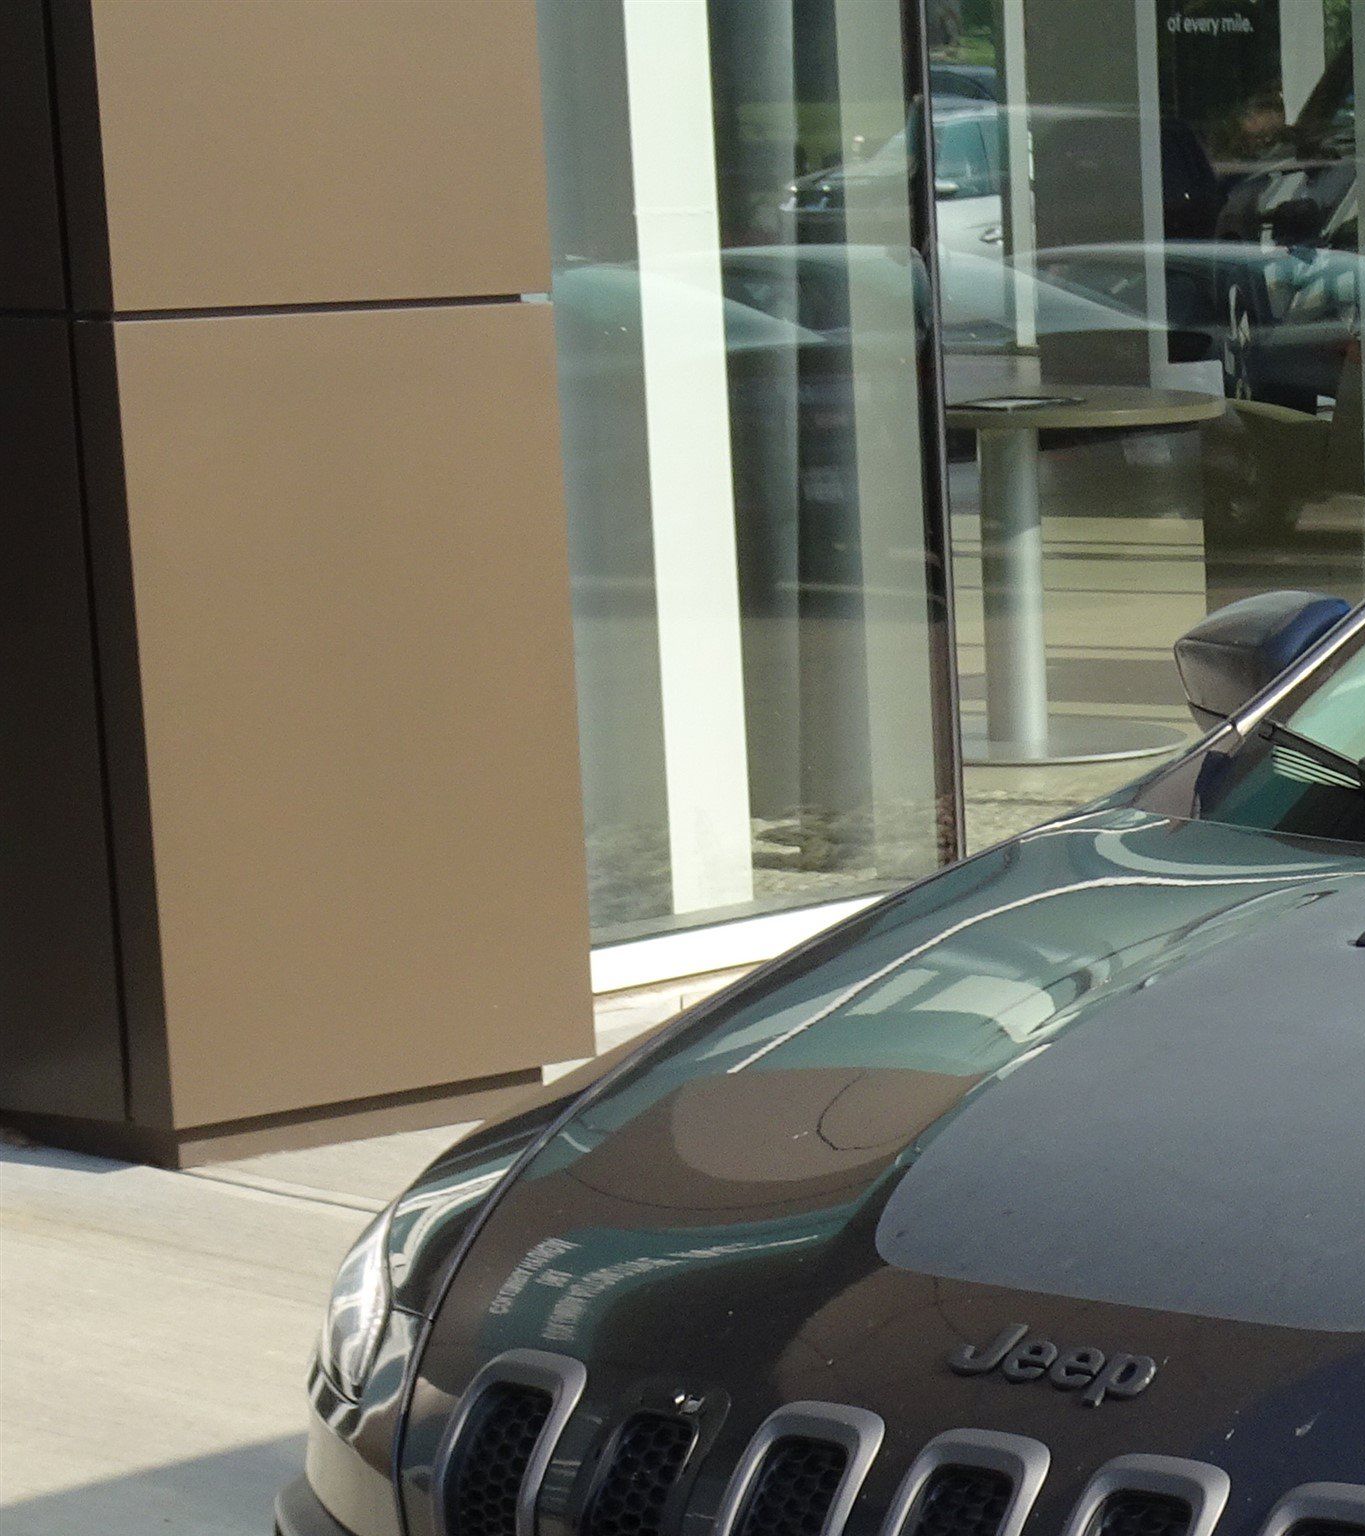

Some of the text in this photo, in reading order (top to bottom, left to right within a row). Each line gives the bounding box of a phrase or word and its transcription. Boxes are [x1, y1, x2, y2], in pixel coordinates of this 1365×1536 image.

[1183, 17, 1218, 36] every
[1221, 13, 1253, 32] mile.
[948, 1322, 1158, 1408] Jeep
